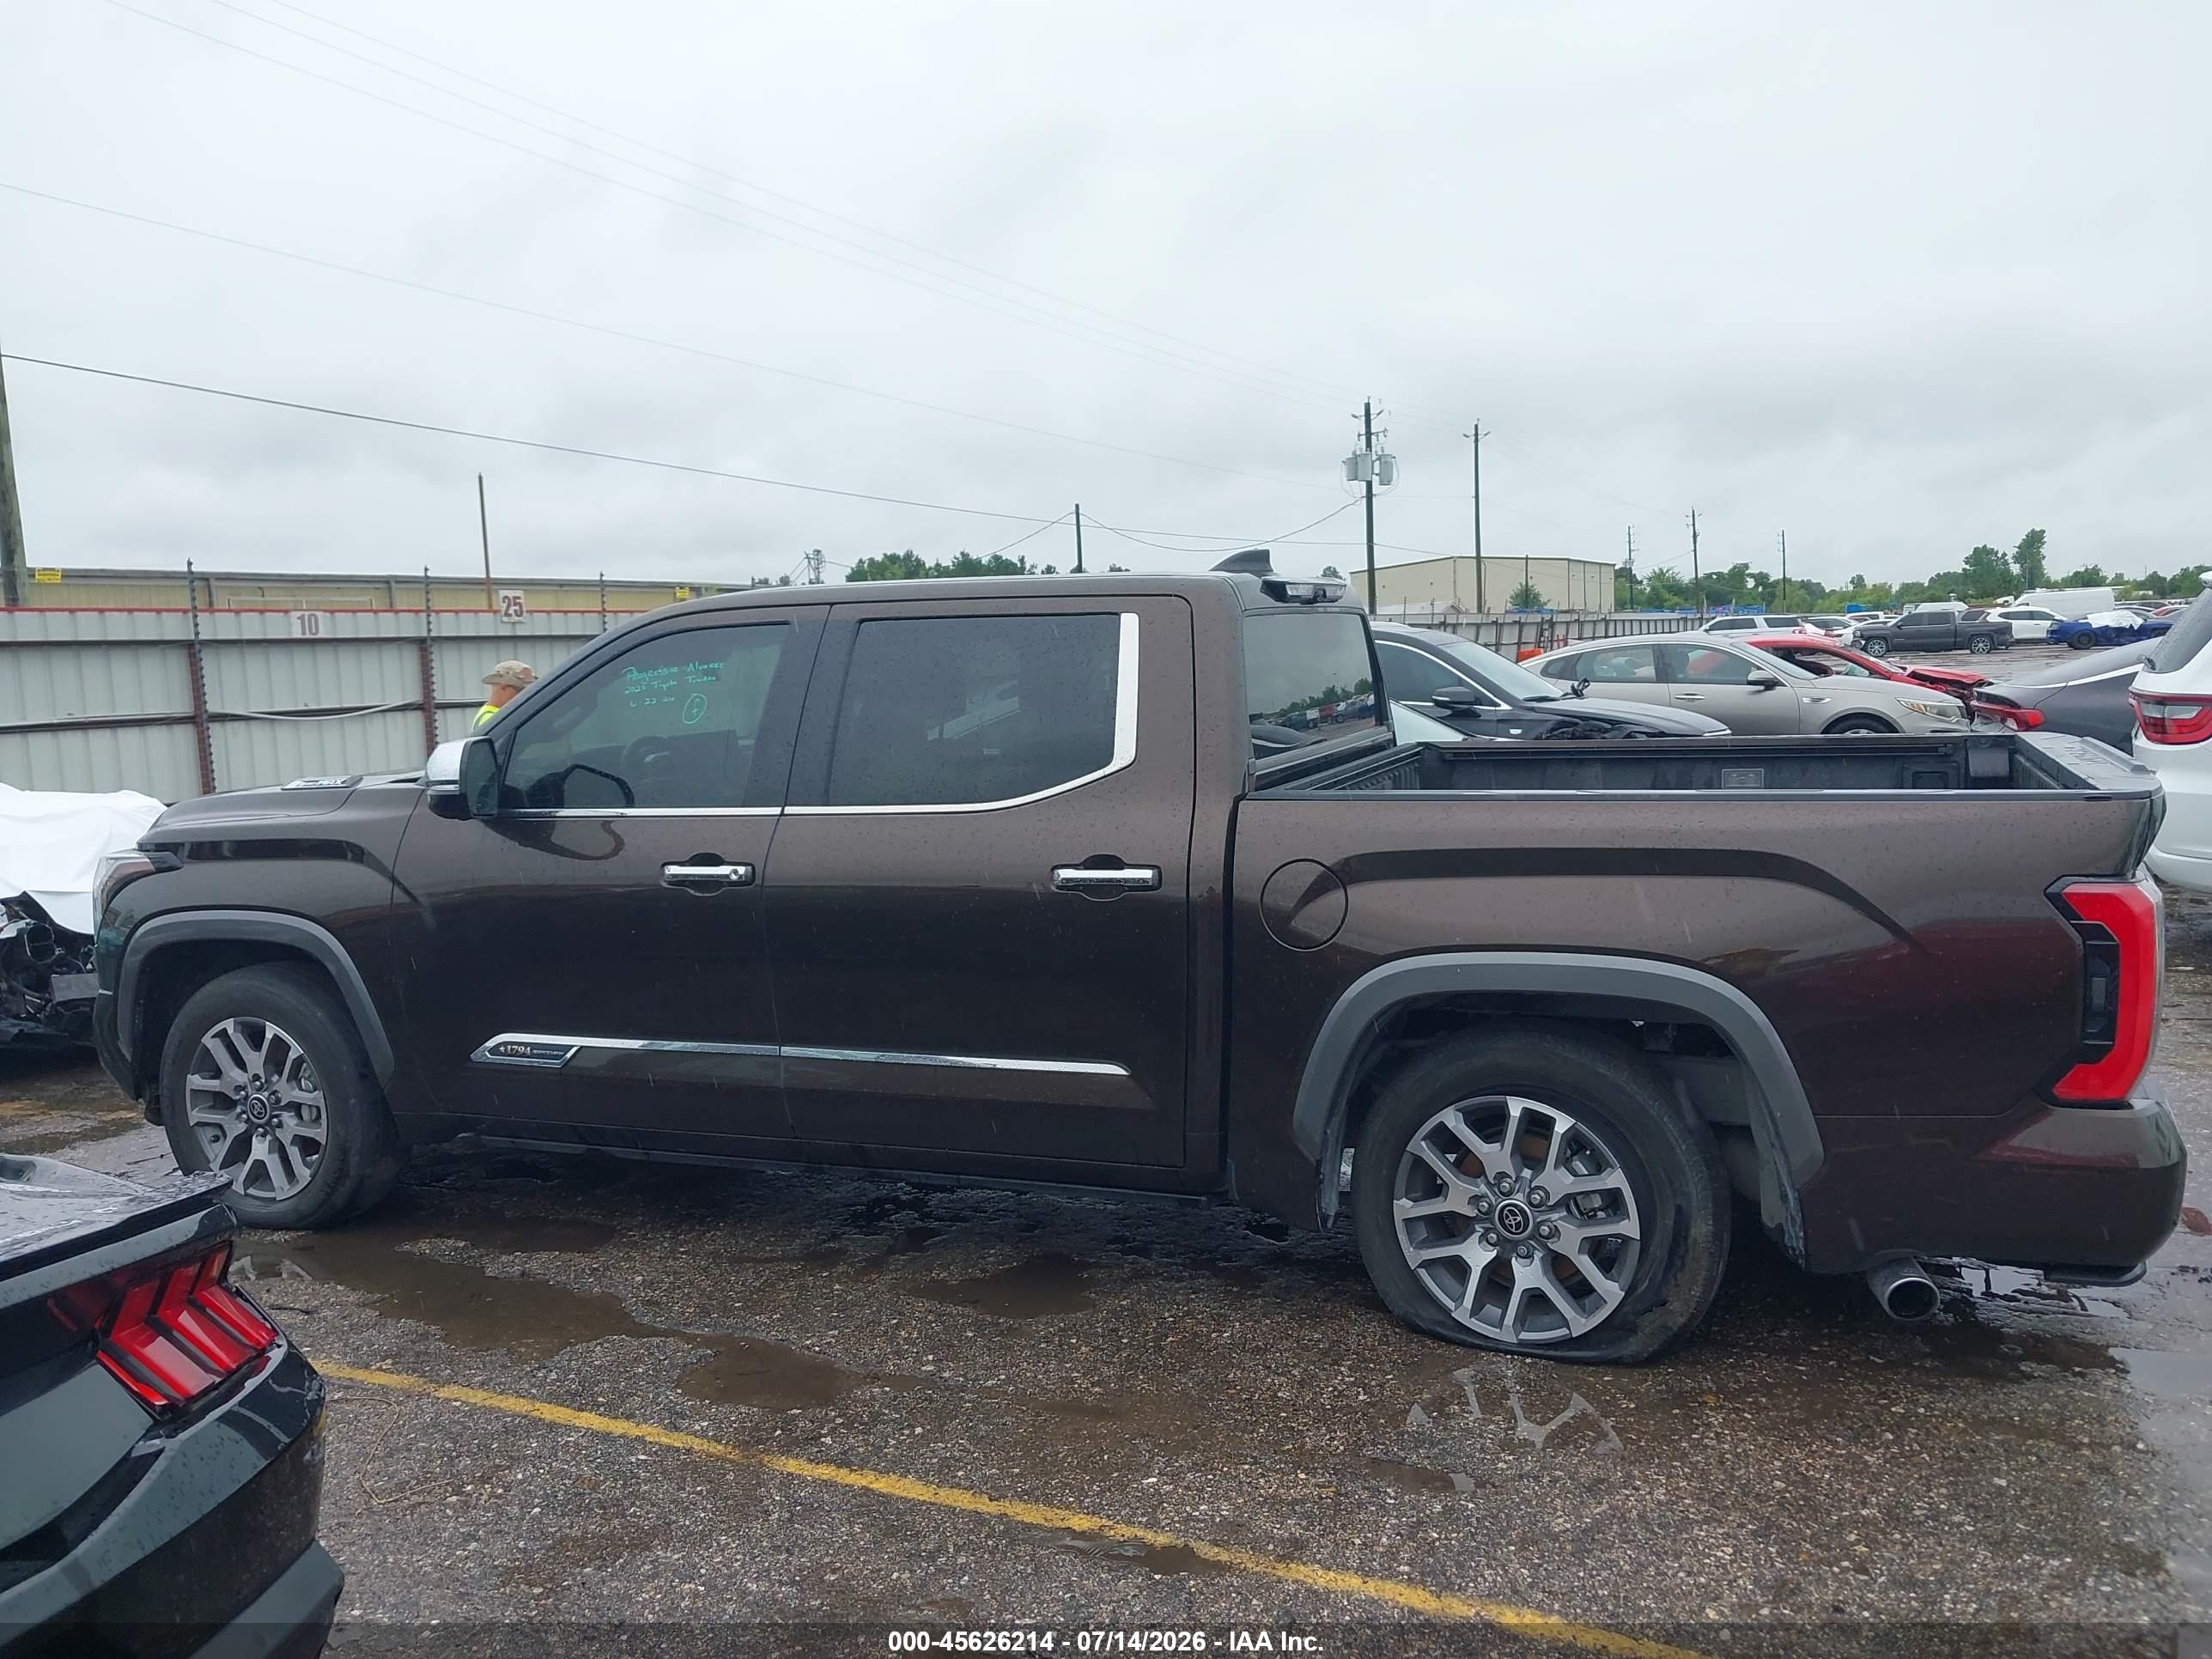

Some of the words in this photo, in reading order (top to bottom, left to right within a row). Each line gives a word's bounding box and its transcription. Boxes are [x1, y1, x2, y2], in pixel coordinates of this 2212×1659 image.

[501, 594, 524, 618] 25
[296, 613, 319, 636] 10
[507, 1044, 532, 1056] 1794
